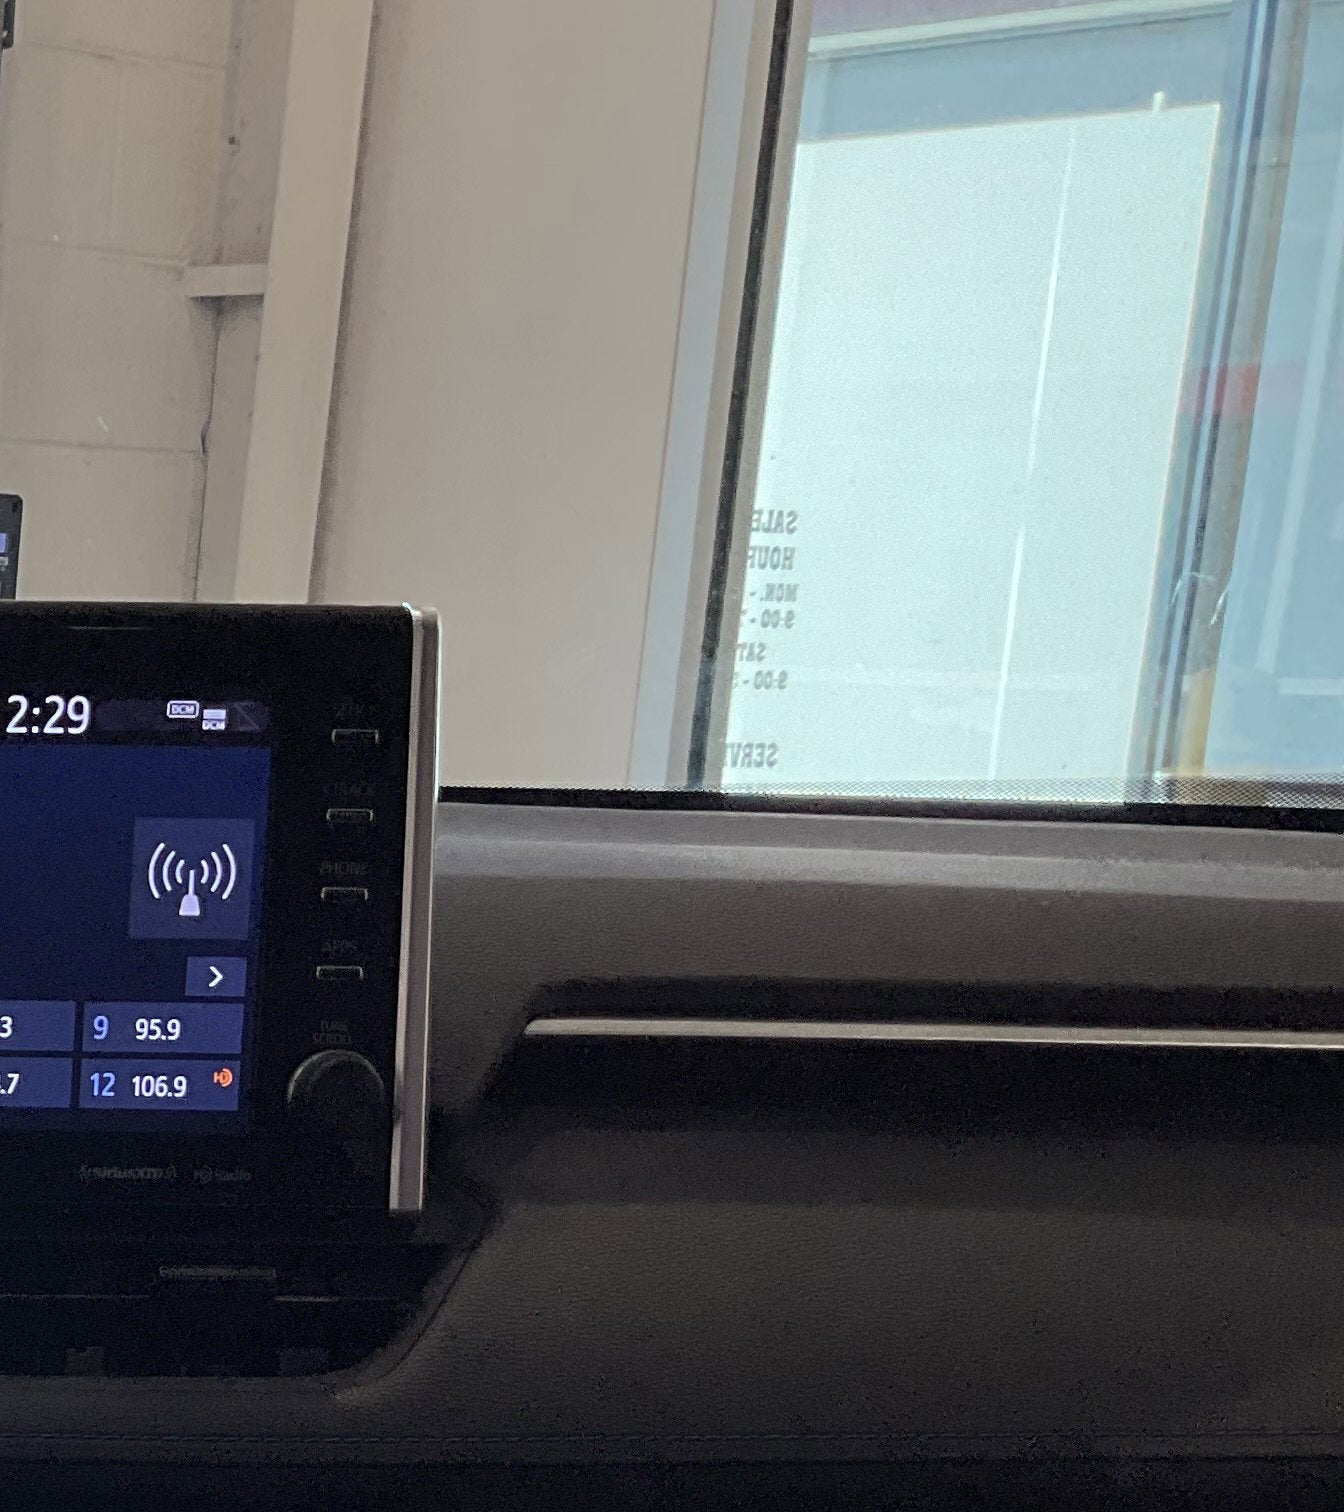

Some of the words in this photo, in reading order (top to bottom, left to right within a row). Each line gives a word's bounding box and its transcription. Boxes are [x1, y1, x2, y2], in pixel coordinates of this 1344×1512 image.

[6, 695, 90, 735] 2:29
[93, 1016, 108, 1040] 9
[135, 1018, 181, 1041] 95.9
[91, 1073, 115, 1097] 12
[131, 1075, 187, 1098] 106.9
